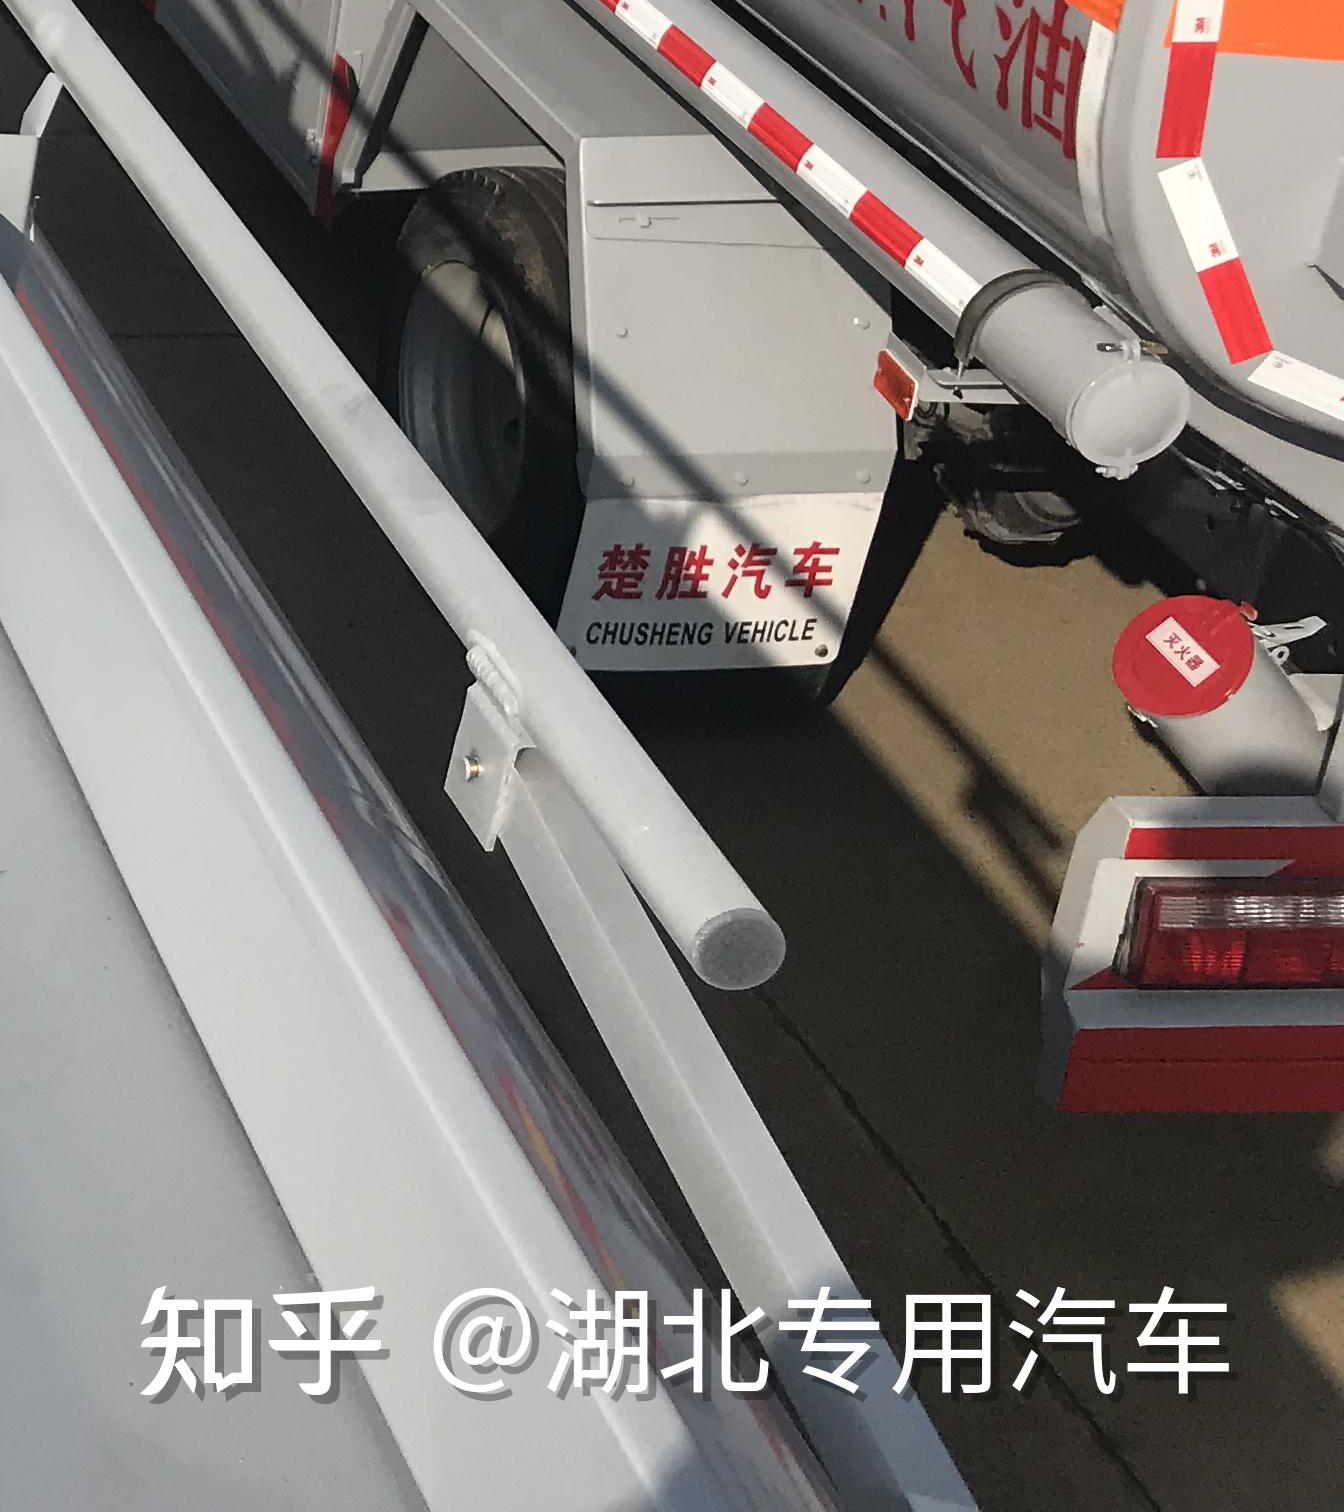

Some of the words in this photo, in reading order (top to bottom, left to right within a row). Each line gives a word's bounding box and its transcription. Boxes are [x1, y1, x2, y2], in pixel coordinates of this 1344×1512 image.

[591, 540, 841, 602] 楚胜汽车
[585, 619, 715, 648] CHUSHENG
[723, 617, 819, 648] VEHICLE
[1162, 631, 1205, 672] 灭火器
